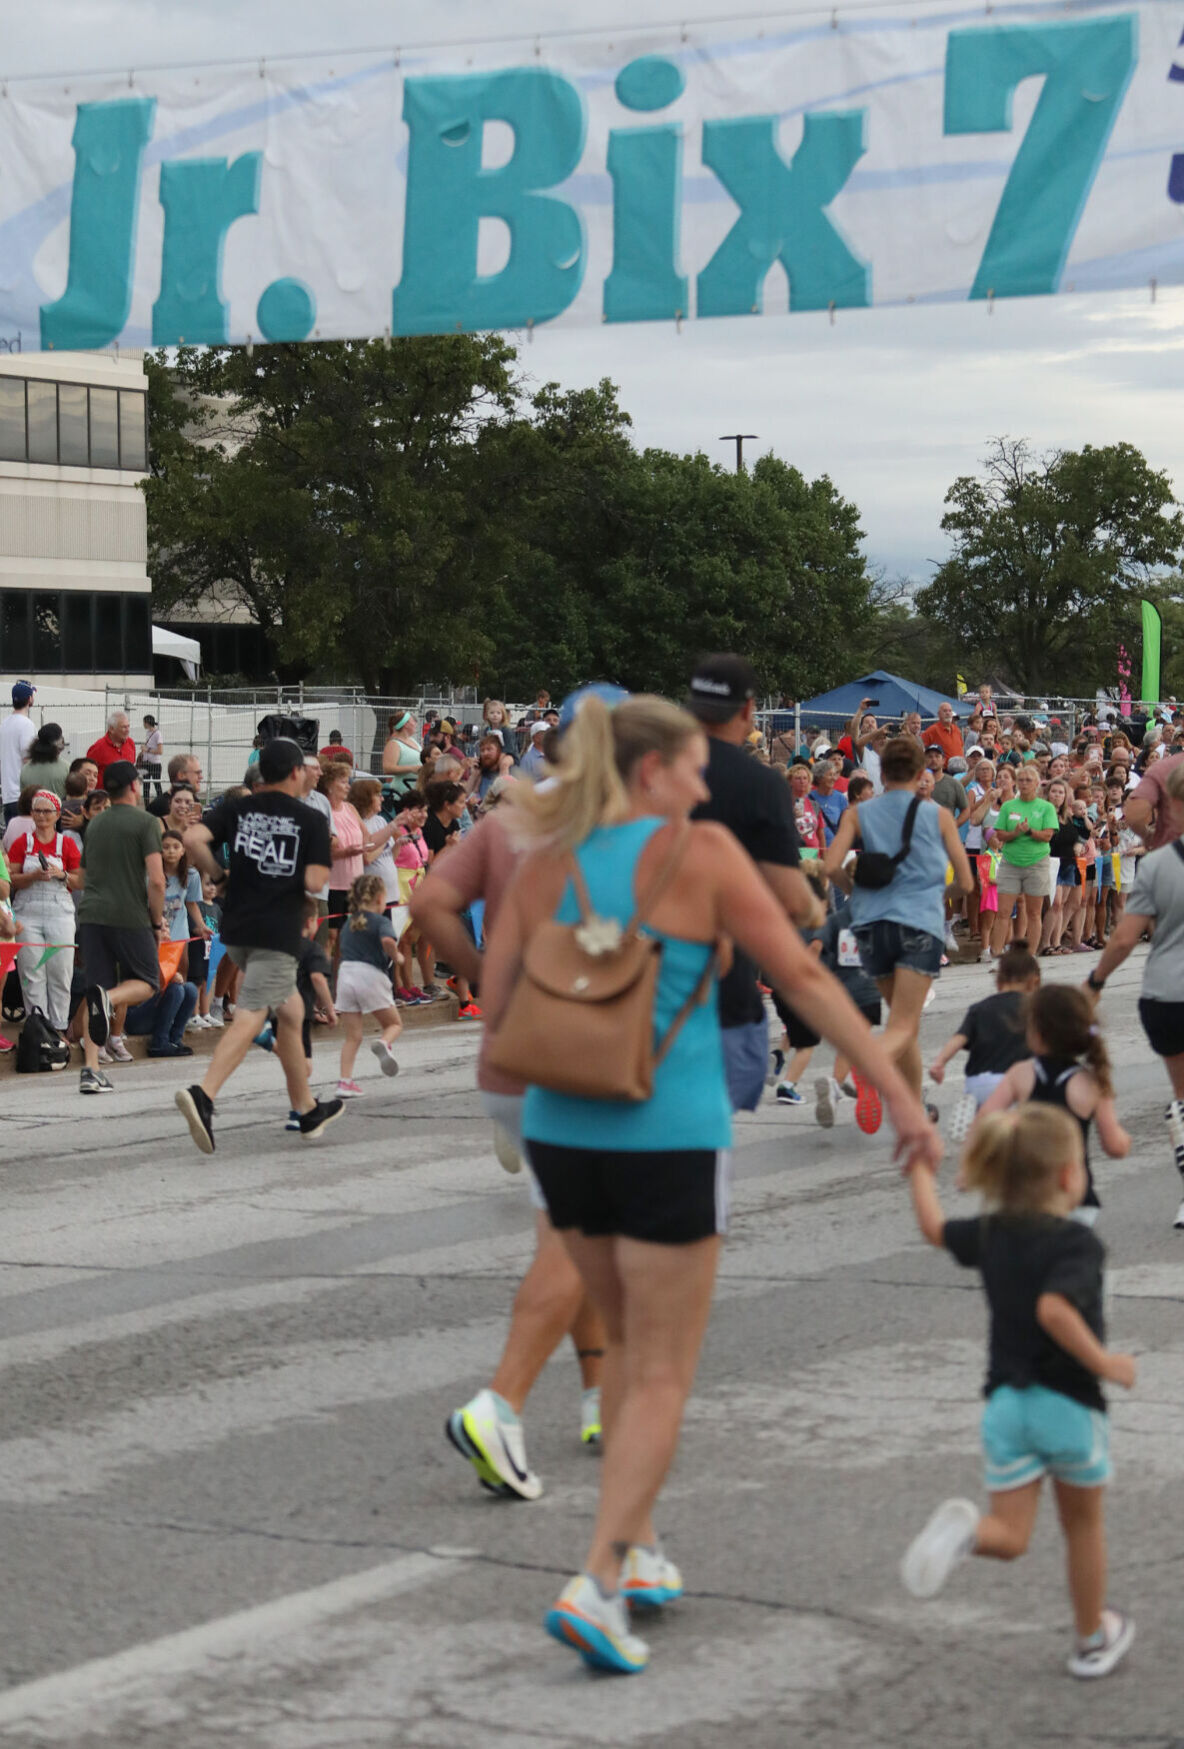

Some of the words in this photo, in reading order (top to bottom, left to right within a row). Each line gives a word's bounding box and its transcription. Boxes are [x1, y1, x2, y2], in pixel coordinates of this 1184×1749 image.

[39, 97, 316, 350] Jr.
[392, 55, 872, 338] Bix
[943, 13, 1139, 300] 7
[234, 831, 295, 865] REAL
